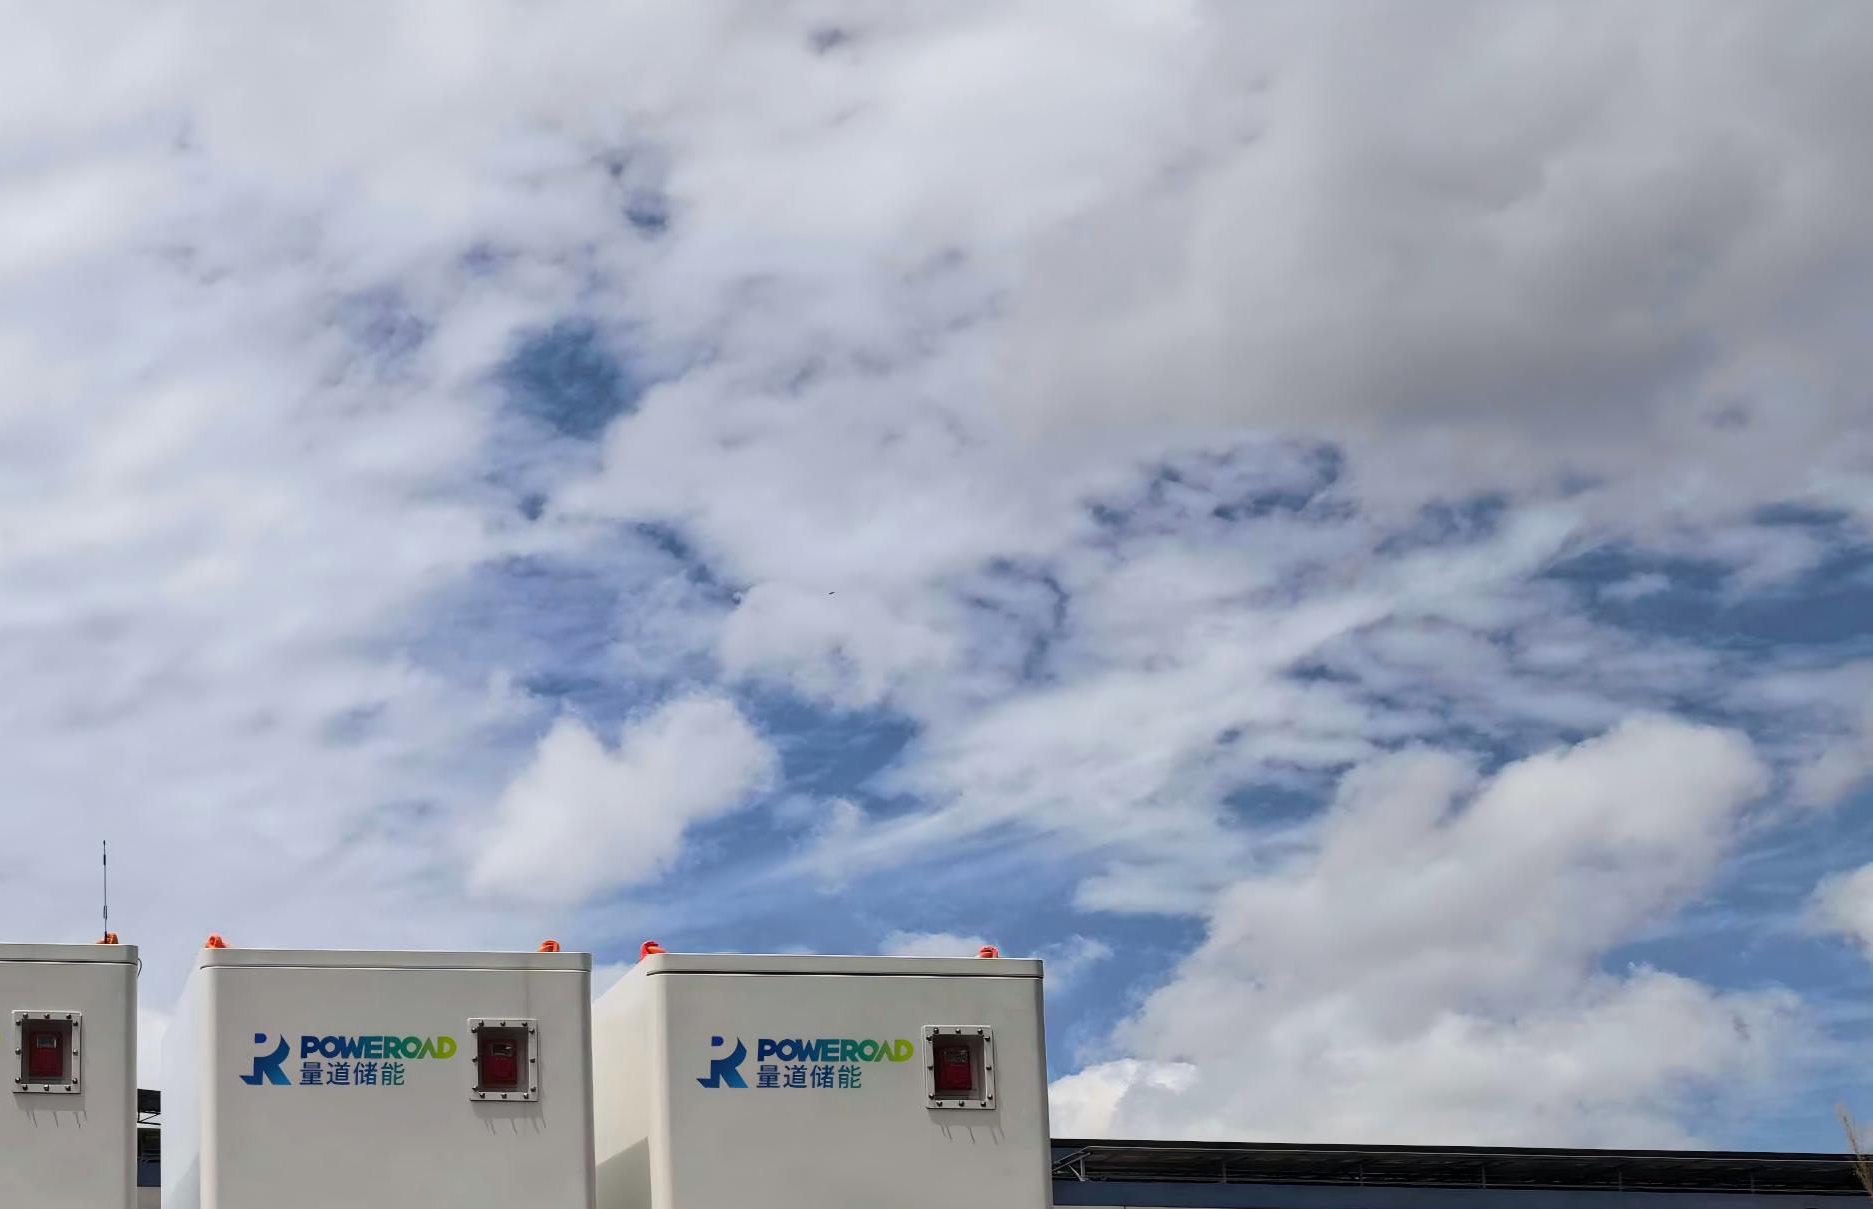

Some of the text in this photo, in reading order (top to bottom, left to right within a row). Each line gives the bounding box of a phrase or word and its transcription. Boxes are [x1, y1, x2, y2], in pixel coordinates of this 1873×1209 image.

[300, 1035, 457, 1059] POWEROAD
[757, 1038, 914, 1062] POWEROAD
[299, 1061, 405, 1086] 量道储能
[756, 1064, 862, 1089] 量道储能
